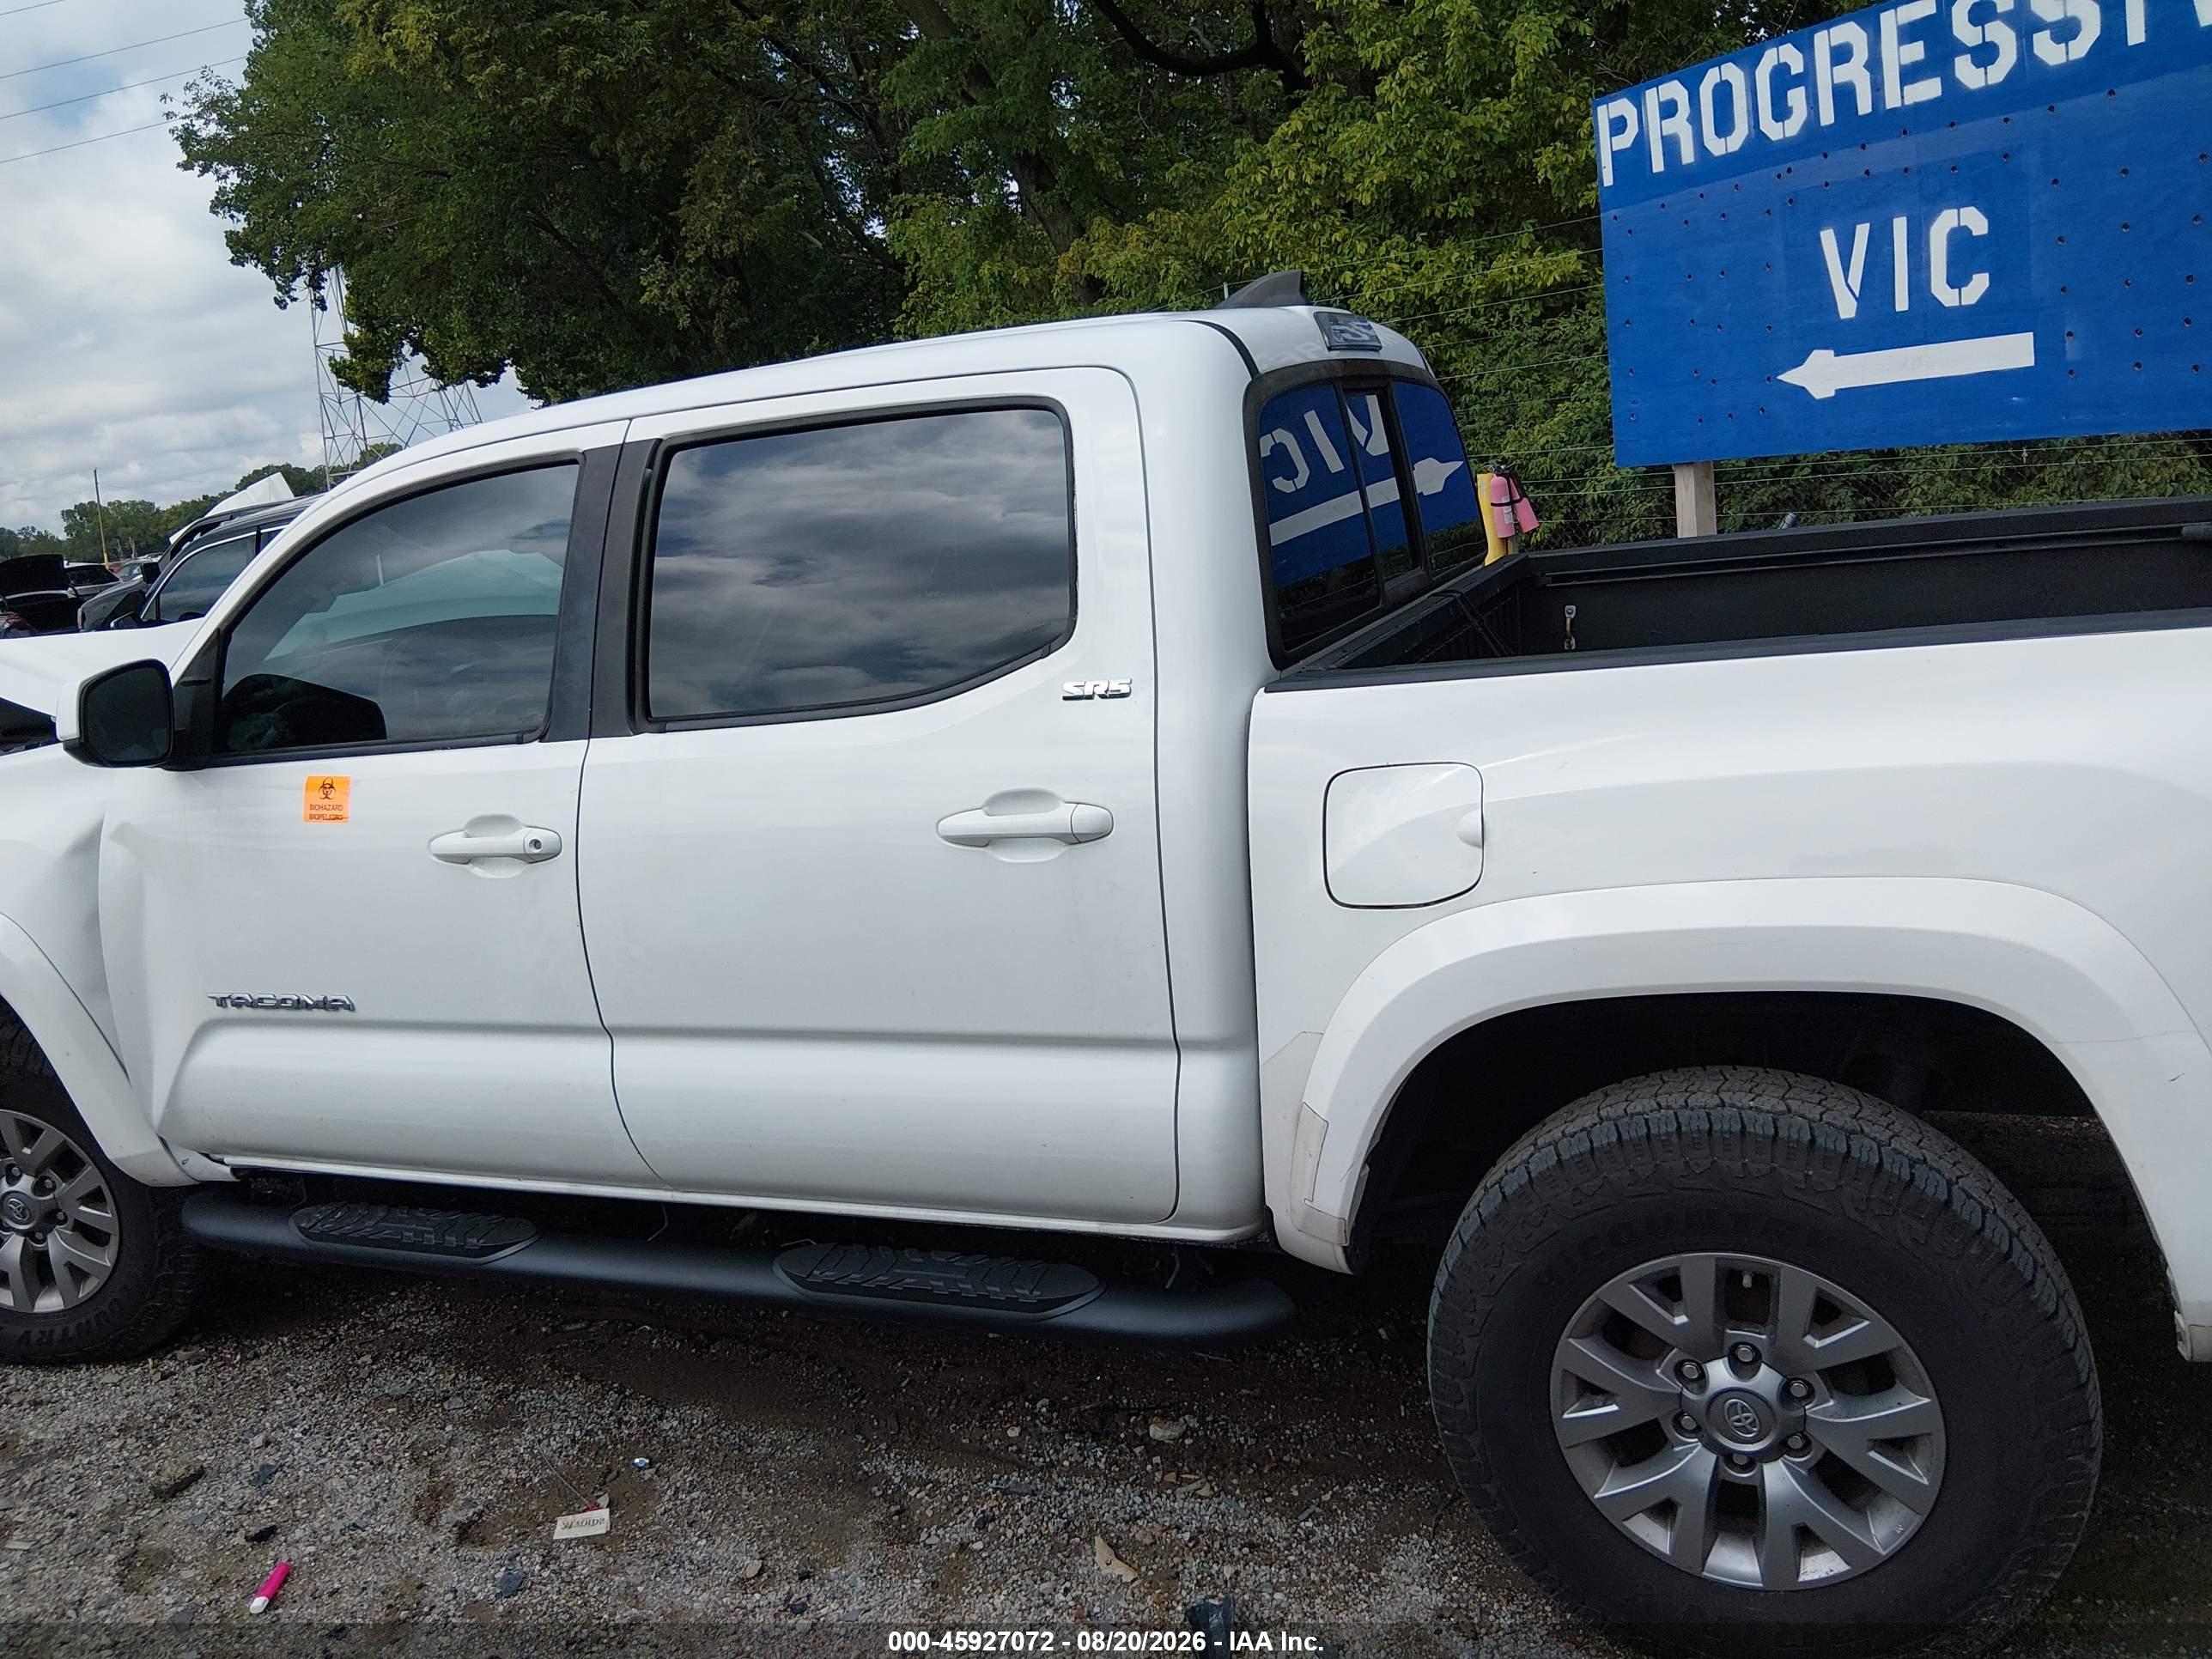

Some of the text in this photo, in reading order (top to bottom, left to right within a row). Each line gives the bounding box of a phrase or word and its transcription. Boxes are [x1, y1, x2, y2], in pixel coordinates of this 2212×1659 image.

[1820, 206, 1990, 319] VIC
[1062, 678, 1132, 701] SR5
[206, 992, 356, 1012] TACOMA
